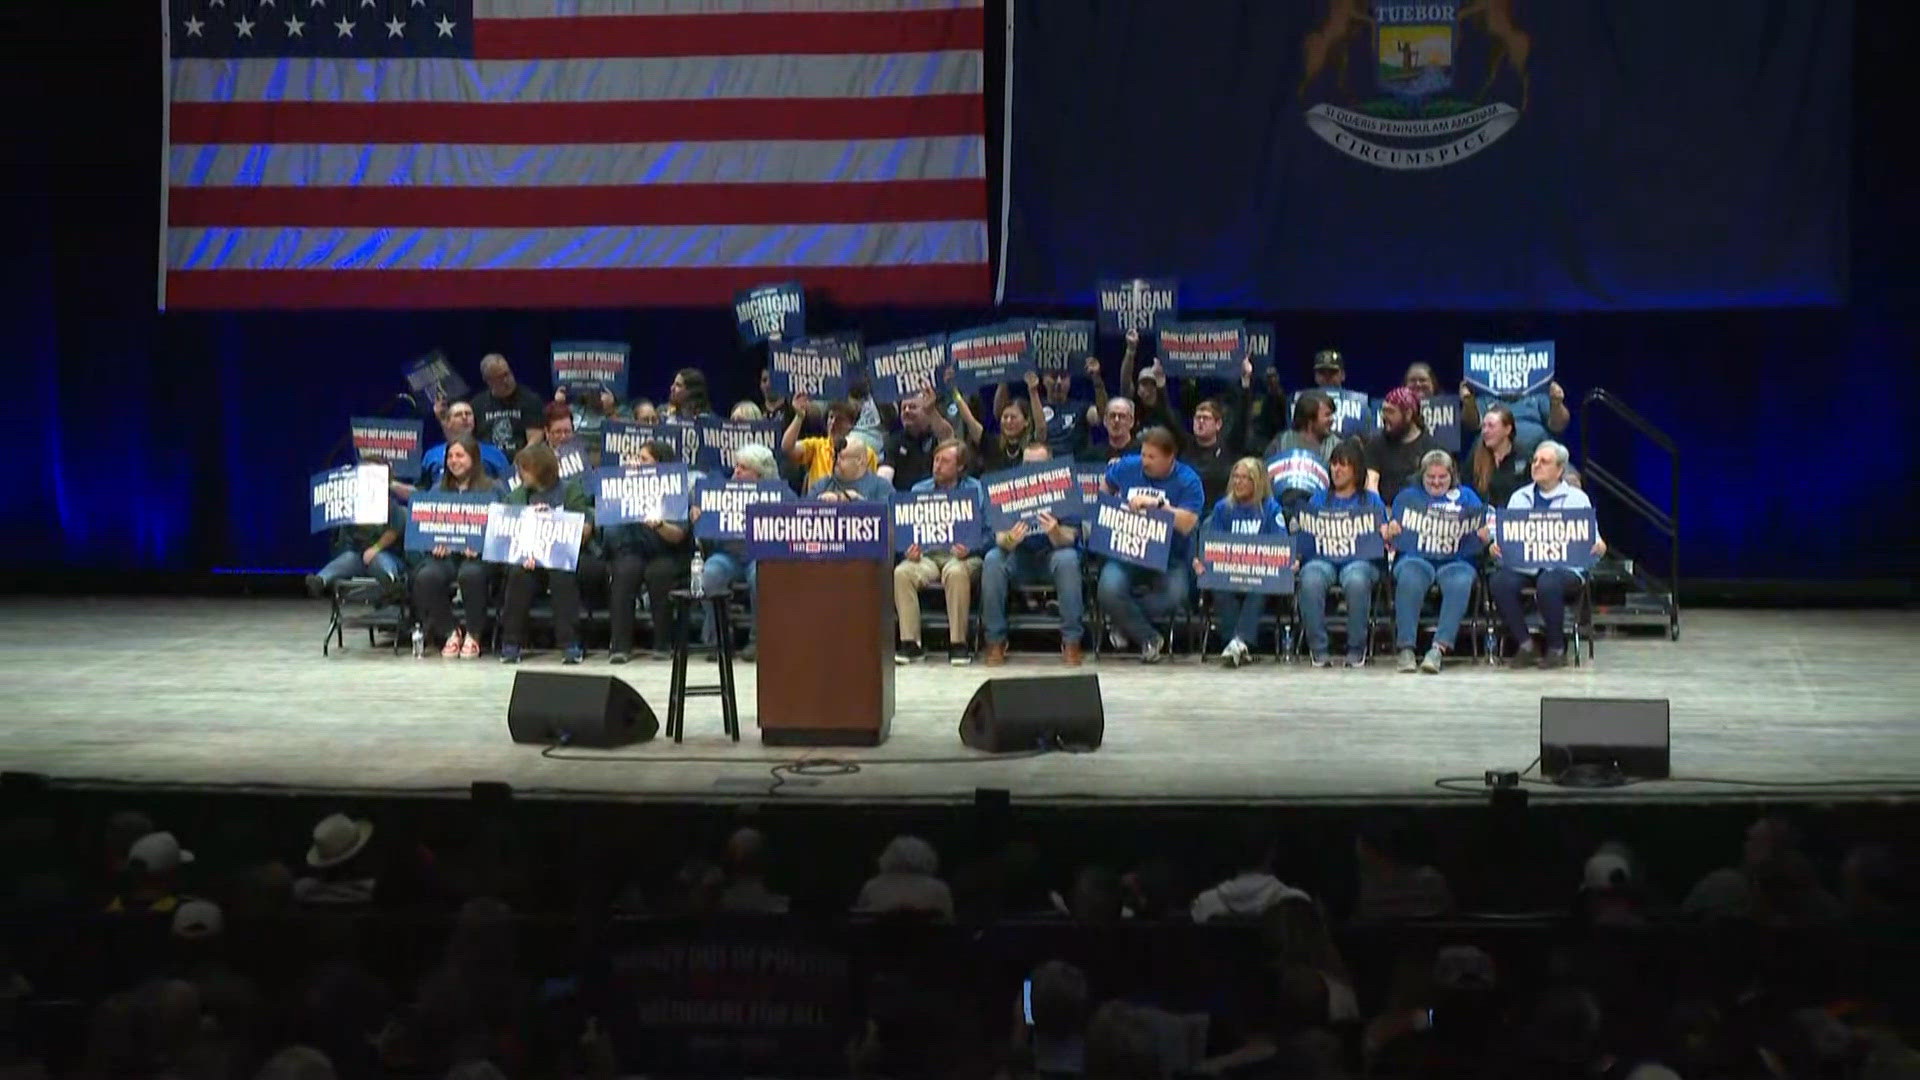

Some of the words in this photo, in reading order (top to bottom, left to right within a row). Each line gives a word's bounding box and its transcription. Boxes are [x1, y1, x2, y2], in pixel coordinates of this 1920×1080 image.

[1376, 5, 1455, 22] TUEBOR
[1380, 121, 1449, 134] PENINSULAM
[1335, 131, 1490, 165] CIRCUMSPICE
[736, 292, 800, 323] MICHIGAN
[752, 311, 787, 337] FIRST
[773, 352, 842, 378] MICHIGAN
[874, 344, 945, 379] MICHIGAN
[1470, 351, 1549, 373] MICHIGAN
[788, 372, 825, 395] FIRST
[896, 367, 937, 395] FIRST
[1489, 371, 1530, 389] FIRST
[703, 427, 776, 450] MICHIGAN
[601, 472, 682, 500] MICHIGAN
[1014, 477, 1029, 489] OUT
[1038, 467, 1072, 483] POLITICS
[701, 489, 782, 512] MICHIGAN
[895, 499, 973, 525] MICHIGAN
[1001, 495, 1038, 513] MEDICARE
[1039, 491, 1054, 506] FOR
[1053, 489, 1066, 502] ALL
[455, 522, 469, 535] FOR
[470, 523, 482, 536] ALL
[753, 516, 835, 542] MICHIGAN
[837, 516, 881, 542] FIRST
[913, 522, 954, 544] FIRST
[1098, 504, 1168, 544] MICHIGAN
[1300, 512, 1375, 538] MICHIGAN
[1401, 507, 1482, 539] MICHIGAN
[1503, 519, 1589, 541] MICHIGAN
[1109, 531, 1148, 560] FIRST
[1204, 540, 1231, 552] MONEY
[1231, 543, 1246, 555] OUT
[1246, 543, 1257, 555] OF
[1257, 544, 1291, 558] POLITICS
[1314, 535, 1358, 558] FIRST
[1417, 533, 1460, 555] FIRST
[1523, 540, 1567, 562] FIRST
[1213, 561, 1251, 575] MEDICARE
[1251, 563, 1266, 576] FOR
[1266, 564, 1279, 577] ALL
